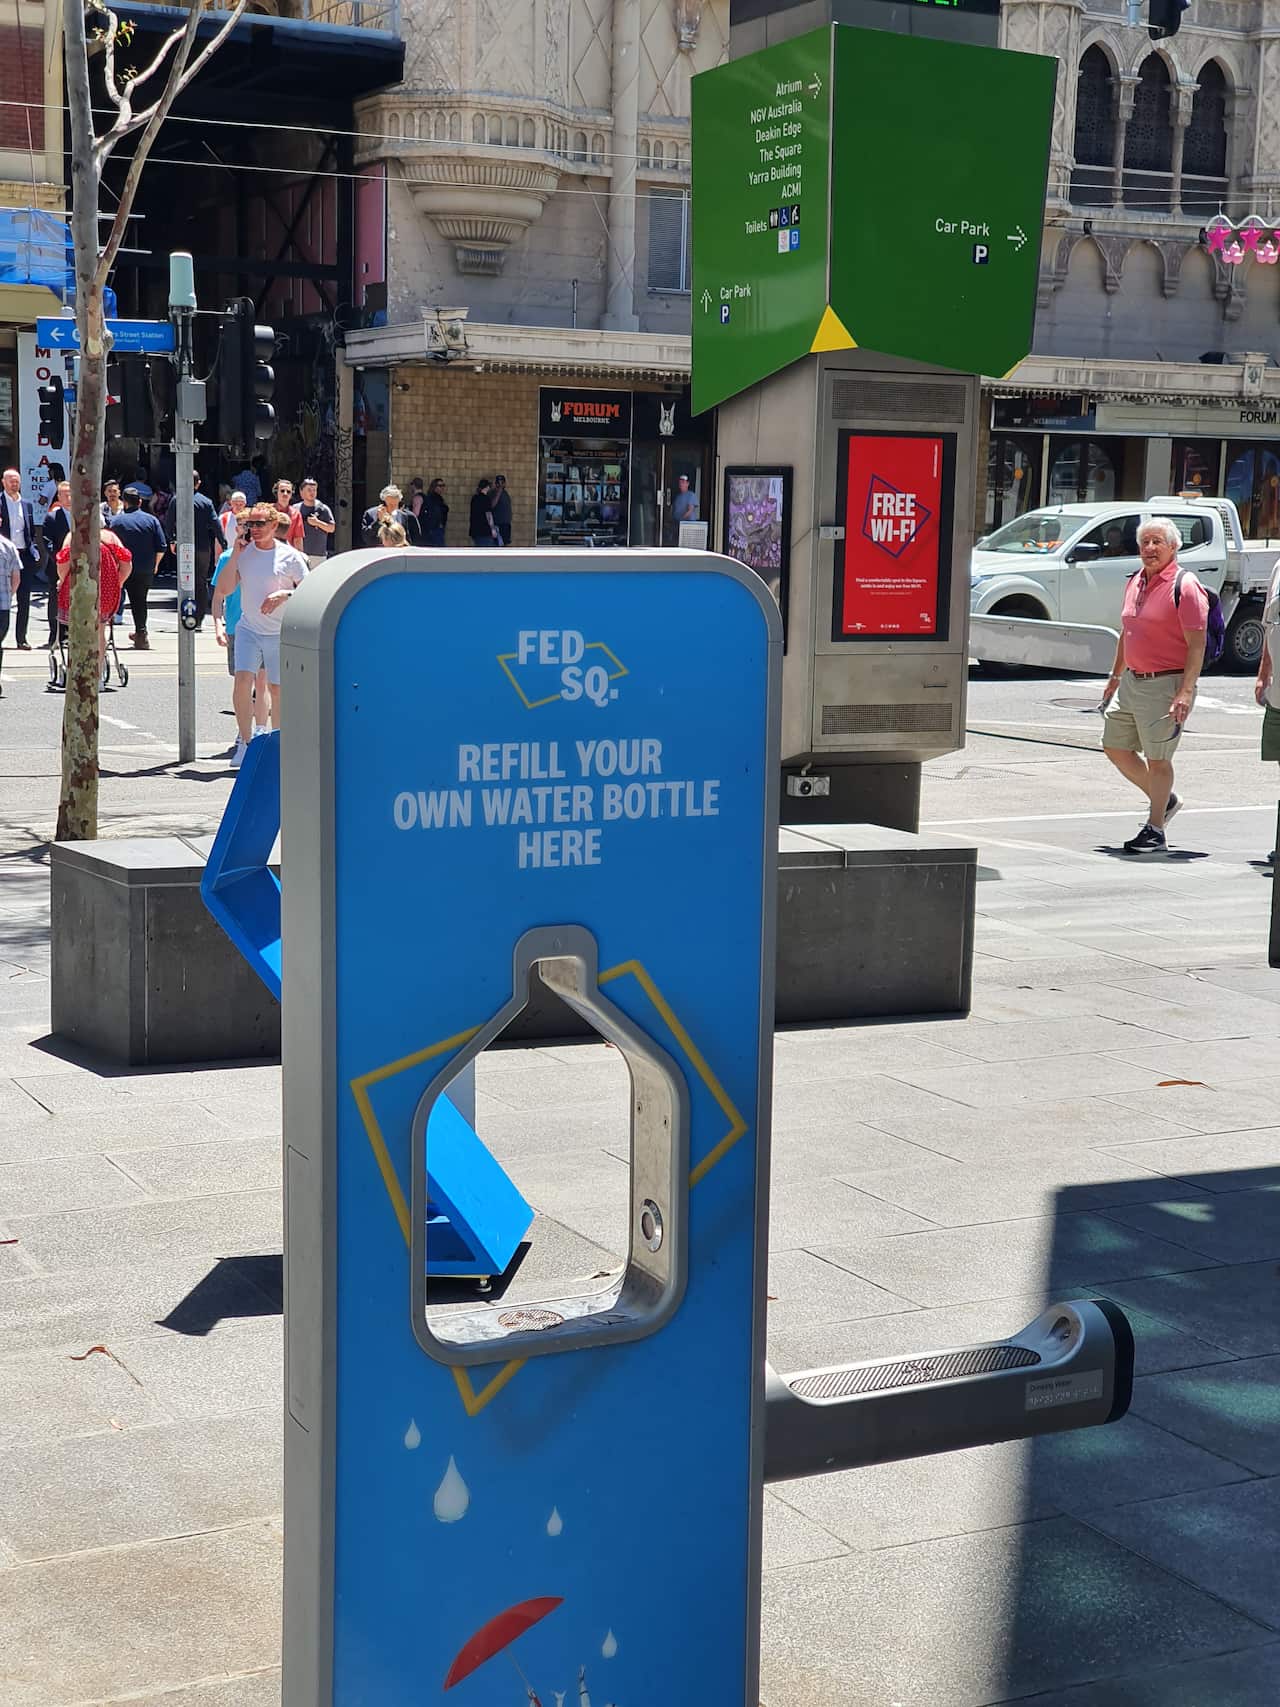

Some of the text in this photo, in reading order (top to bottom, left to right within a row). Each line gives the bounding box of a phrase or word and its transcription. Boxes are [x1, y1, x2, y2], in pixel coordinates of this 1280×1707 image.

[776, 79, 802, 97] Atrium
[750, 99, 802, 125] NGV Australia
[755, 121, 802, 143] Deakin Edge
[760, 143, 802, 163] The Square
[749, 163, 802, 186] Yarra Building
[781, 182, 801, 199] ACMI
[745, 220, 768, 235] Toilets
[935, 218, 990, 236] Car Park
[975, 245, 988, 263] P
[720, 283, 751, 300] Car Park
[722, 305, 729, 323] P
[563, 401, 620, 417] FORUM
[1240, 410, 1277, 424] FORUM
[872, 492, 916, 517] FREE
[871, 518, 916, 543] WI-FI
[517, 629, 585, 665] FED
[559, 665, 619, 707] SQ.
[457, 738, 662, 782] REFILL YOUR
[393, 779, 721, 830] OWN WATER BOTTLE
[518, 829, 602, 869] HERE
